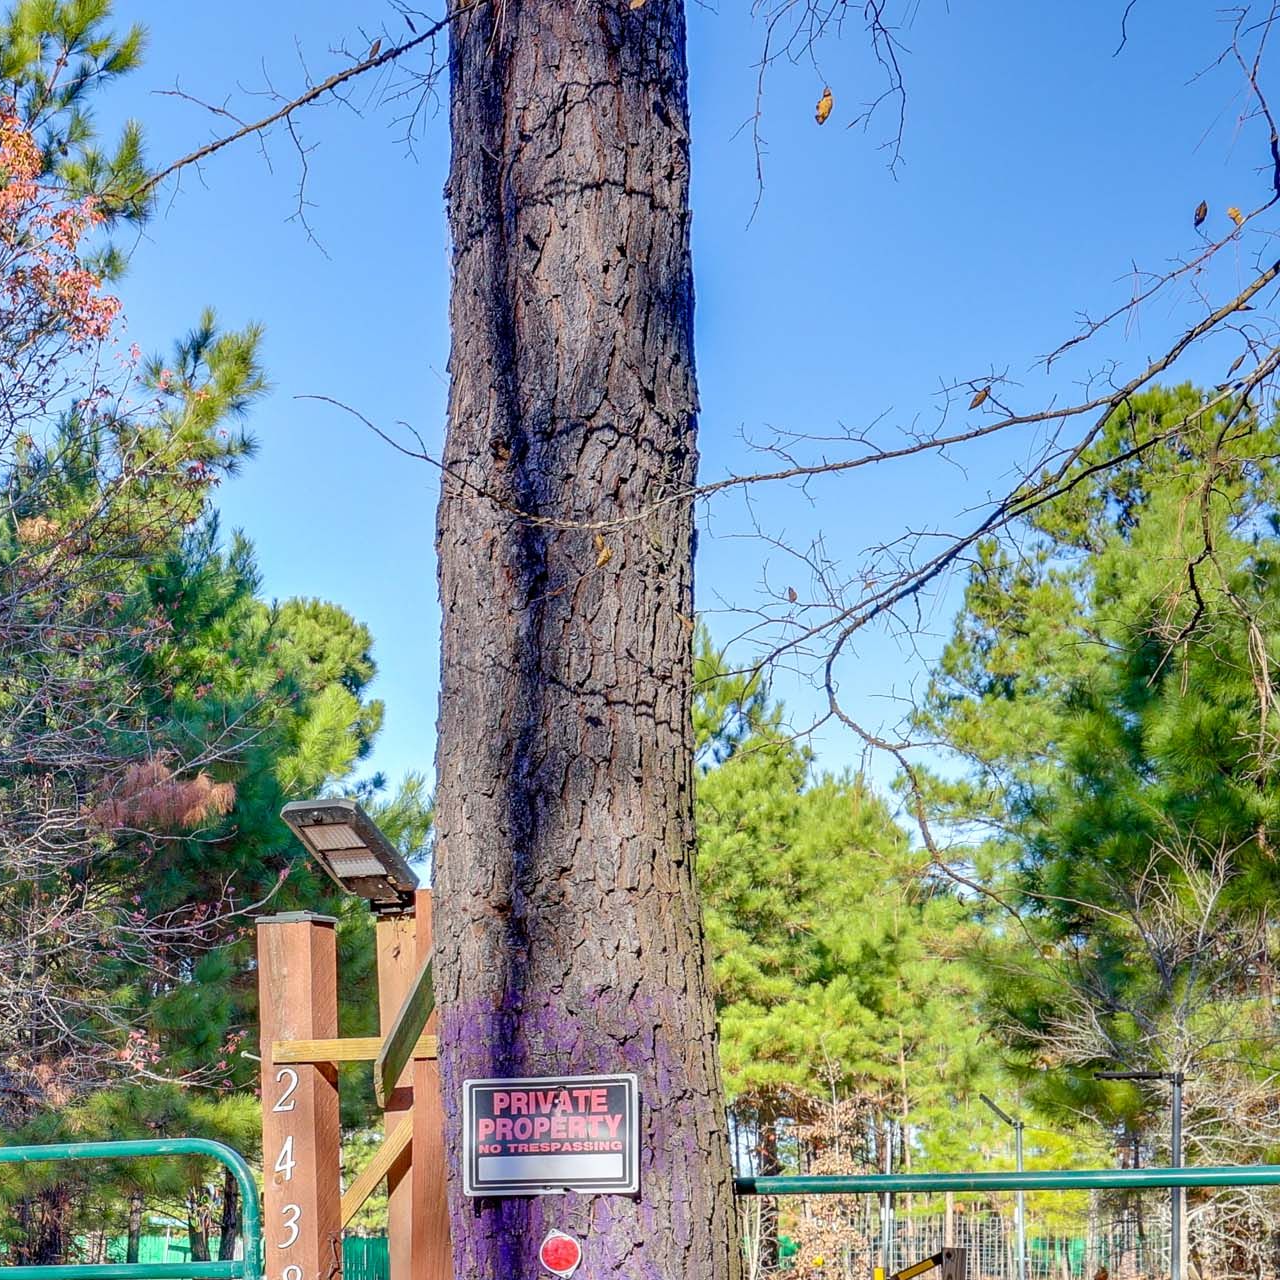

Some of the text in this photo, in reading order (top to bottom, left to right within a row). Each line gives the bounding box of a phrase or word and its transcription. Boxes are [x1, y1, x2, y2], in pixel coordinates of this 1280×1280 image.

[493, 1088, 608, 1115] PRIVATE
[478, 1114, 623, 1140] PROPERTY
[478, 1140, 623, 1153] NO TRESPASSING
